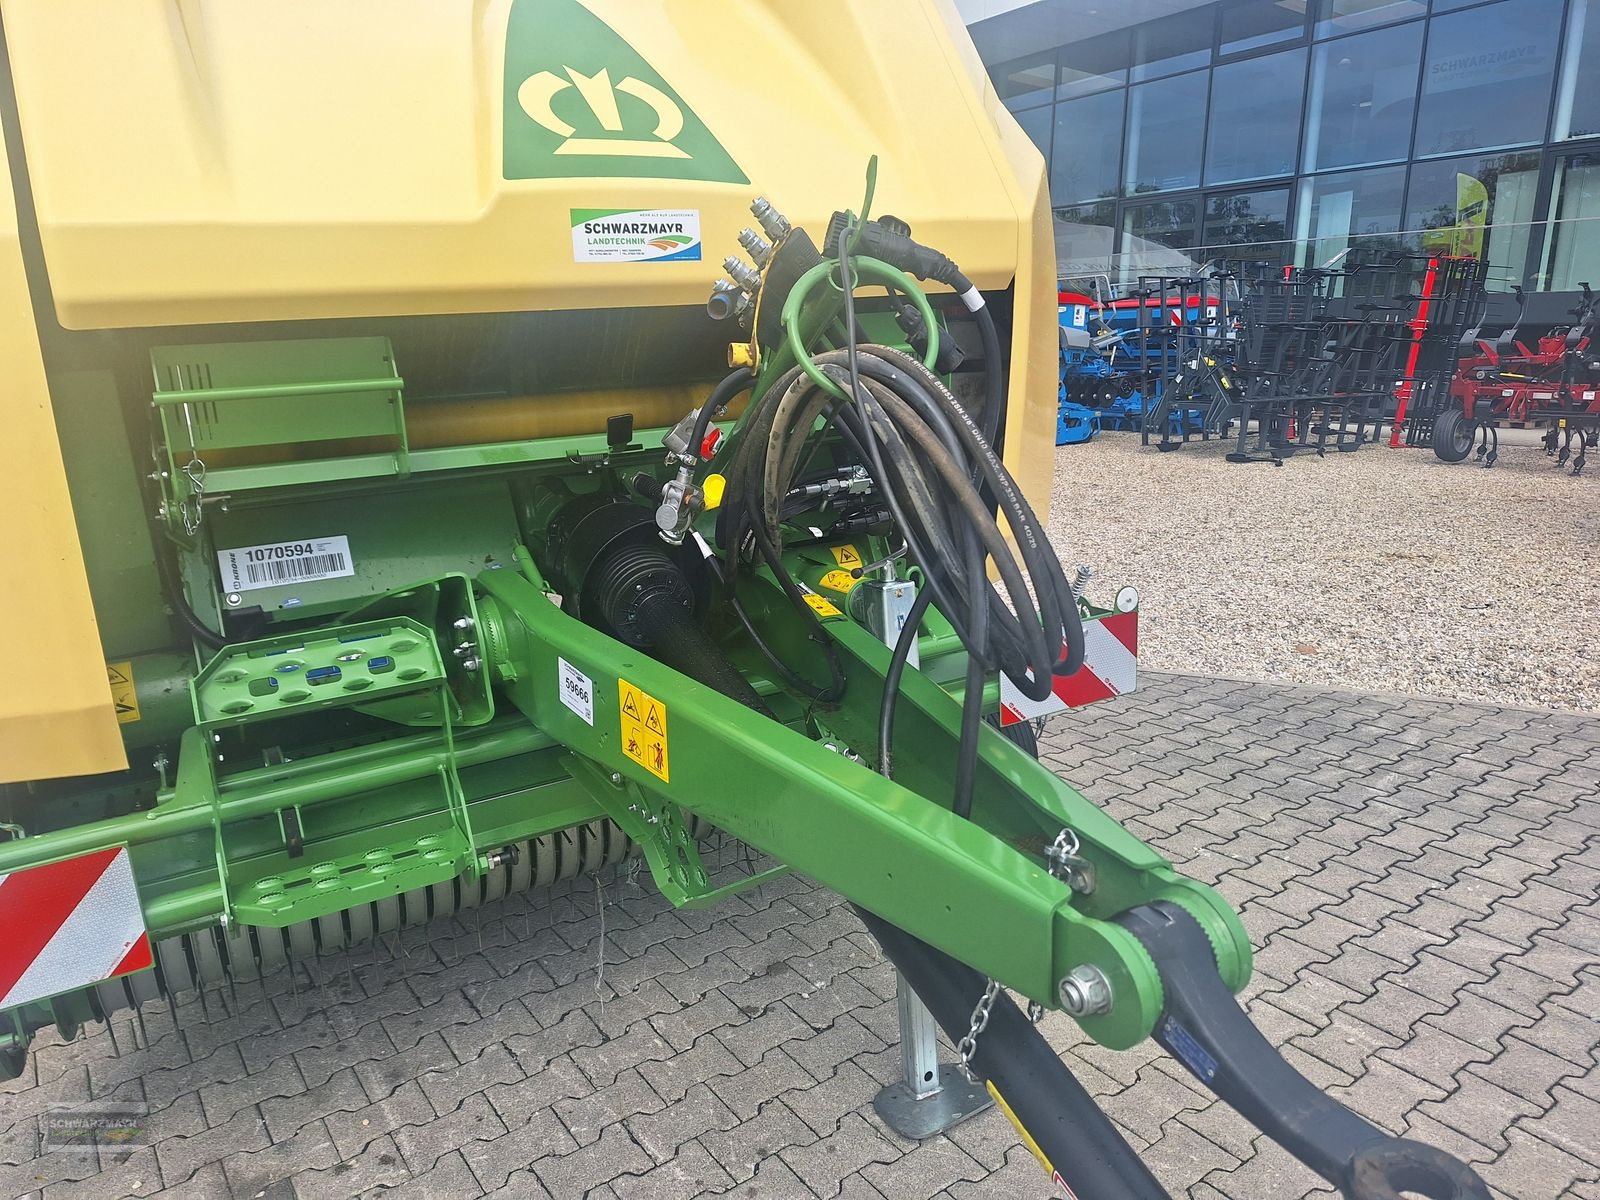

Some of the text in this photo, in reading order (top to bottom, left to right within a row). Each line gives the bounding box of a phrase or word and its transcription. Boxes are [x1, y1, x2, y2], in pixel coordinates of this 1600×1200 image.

[584, 222, 683, 234] SCHWARZMAYR
[587, 237, 646, 245] LANDTECHNIK
[244, 542, 314, 562] 1070594
[229, 552, 241, 581] KRONE
[565, 677, 590, 704] 59666
